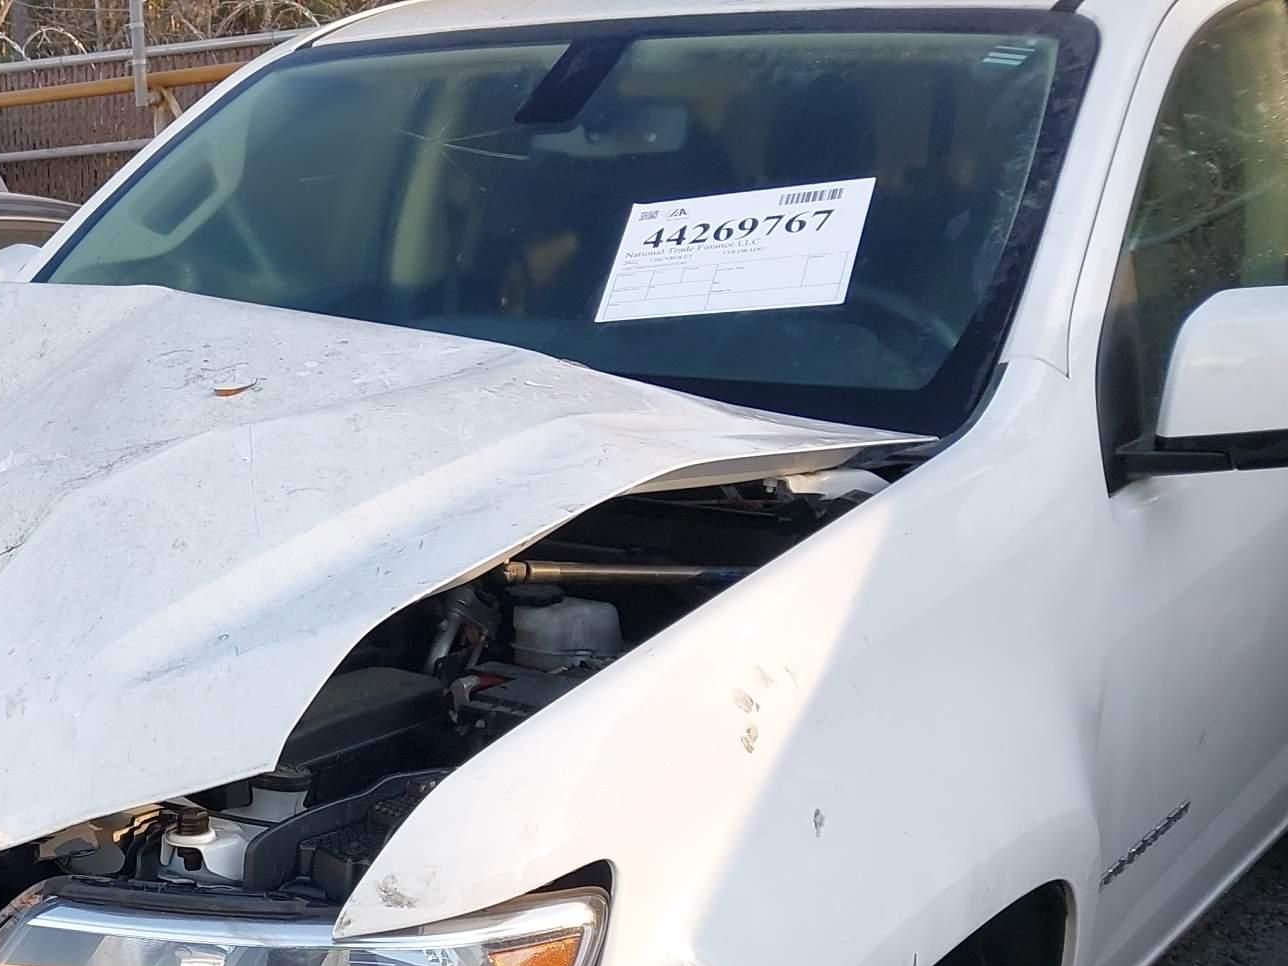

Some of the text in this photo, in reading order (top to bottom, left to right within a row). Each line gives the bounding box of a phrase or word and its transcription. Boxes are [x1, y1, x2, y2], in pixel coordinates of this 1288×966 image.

[643, 208, 836, 248] 44269767
[625, 238, 761, 260] National Trade Finance LLC
